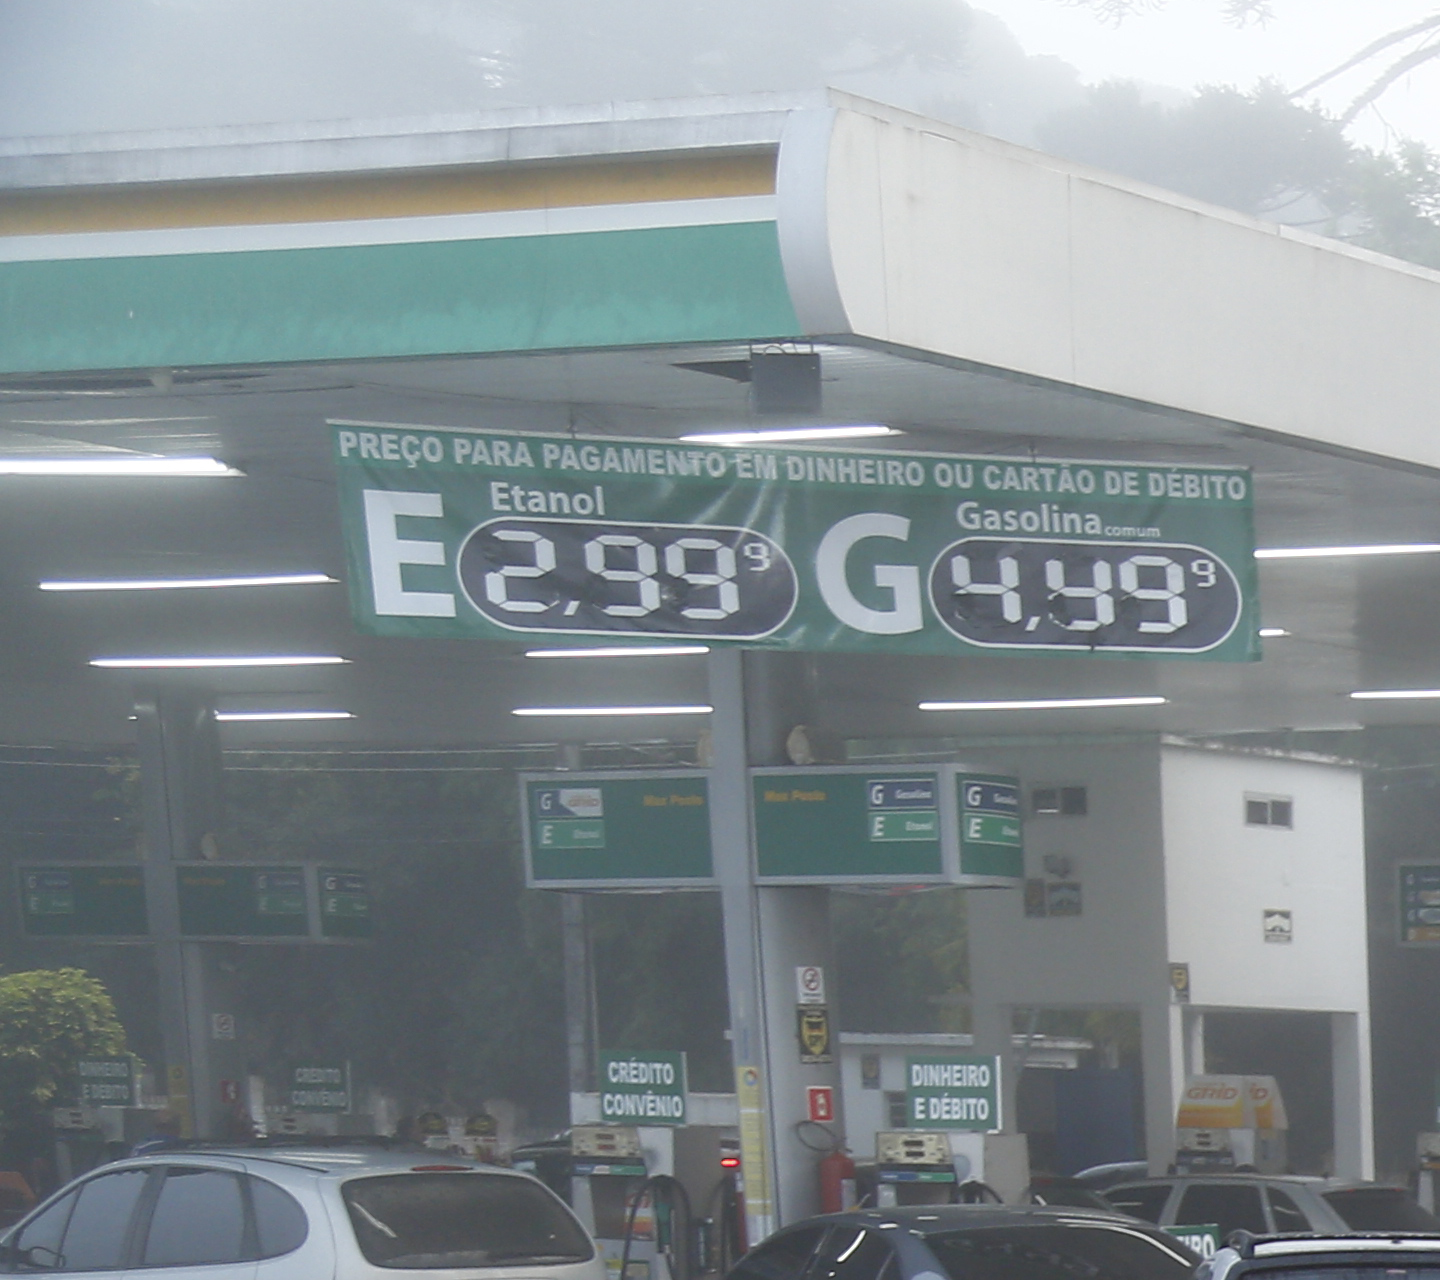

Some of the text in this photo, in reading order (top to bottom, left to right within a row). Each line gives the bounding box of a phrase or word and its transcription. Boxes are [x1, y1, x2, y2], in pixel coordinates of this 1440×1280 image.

[339, 430, 1246, 500] PREÇO PARA PAGAMENTO EM DINHEIRO OU CARTÃO DE DÉBITO
[490, 481, 606, 516] Etanol
[956, 501, 1161, 539] Gasolina comum
[363, 489, 456, 617] E
[816, 512, 924, 635] G
[541, 793, 551, 810] G
[871, 784, 885, 805] G
[967, 786, 982, 806] G
[542, 825, 553, 844] E
[872, 816, 885, 837] E
[968, 818, 983, 838] E
[608, 1057, 675, 1085] CRÉDITO
[912, 1064, 991, 1087] DINHEIRO
[603, 1090, 683, 1118] CONVÊNIO
[914, 1093, 990, 1120] E DÉBITO
